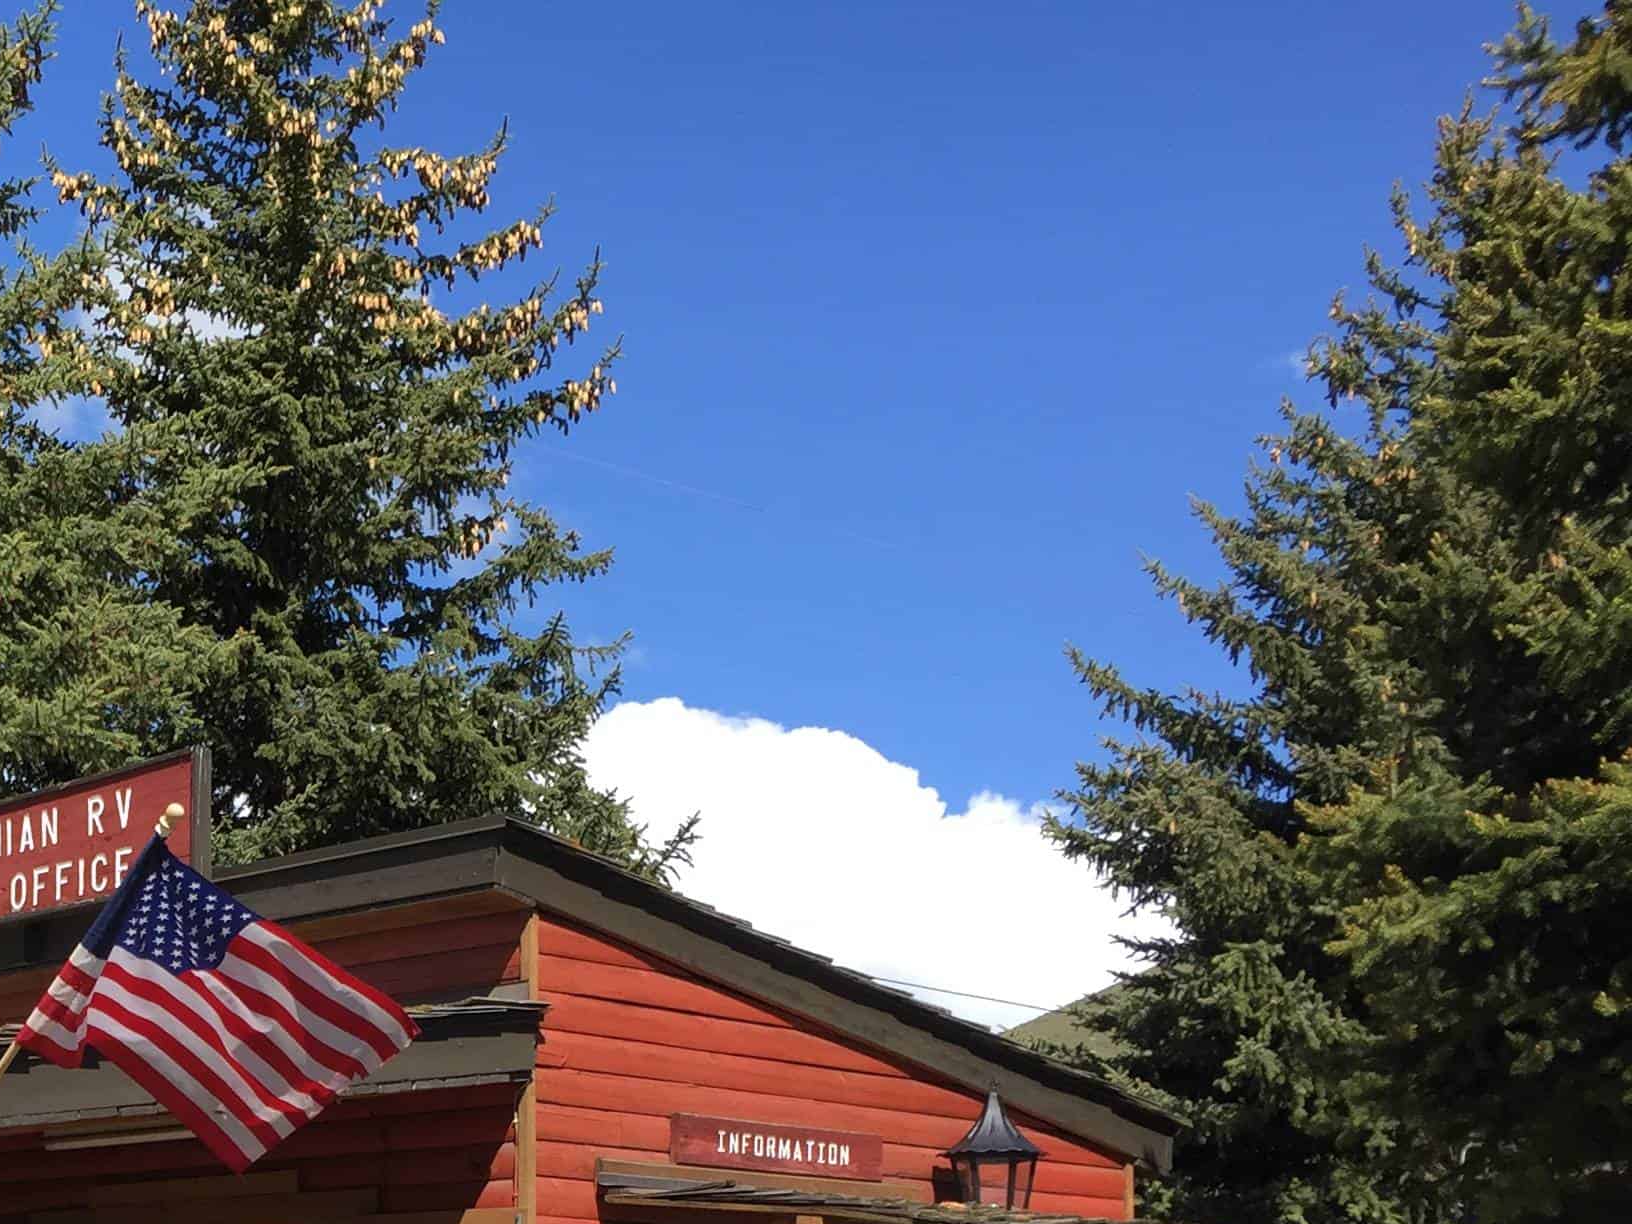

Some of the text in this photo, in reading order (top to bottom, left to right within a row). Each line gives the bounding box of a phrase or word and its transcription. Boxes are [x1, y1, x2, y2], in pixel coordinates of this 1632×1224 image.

[86, 787, 133, 836] RV
[9, 847, 134, 913] OFFICE
[716, 1130, 851, 1166] INFORMATION
